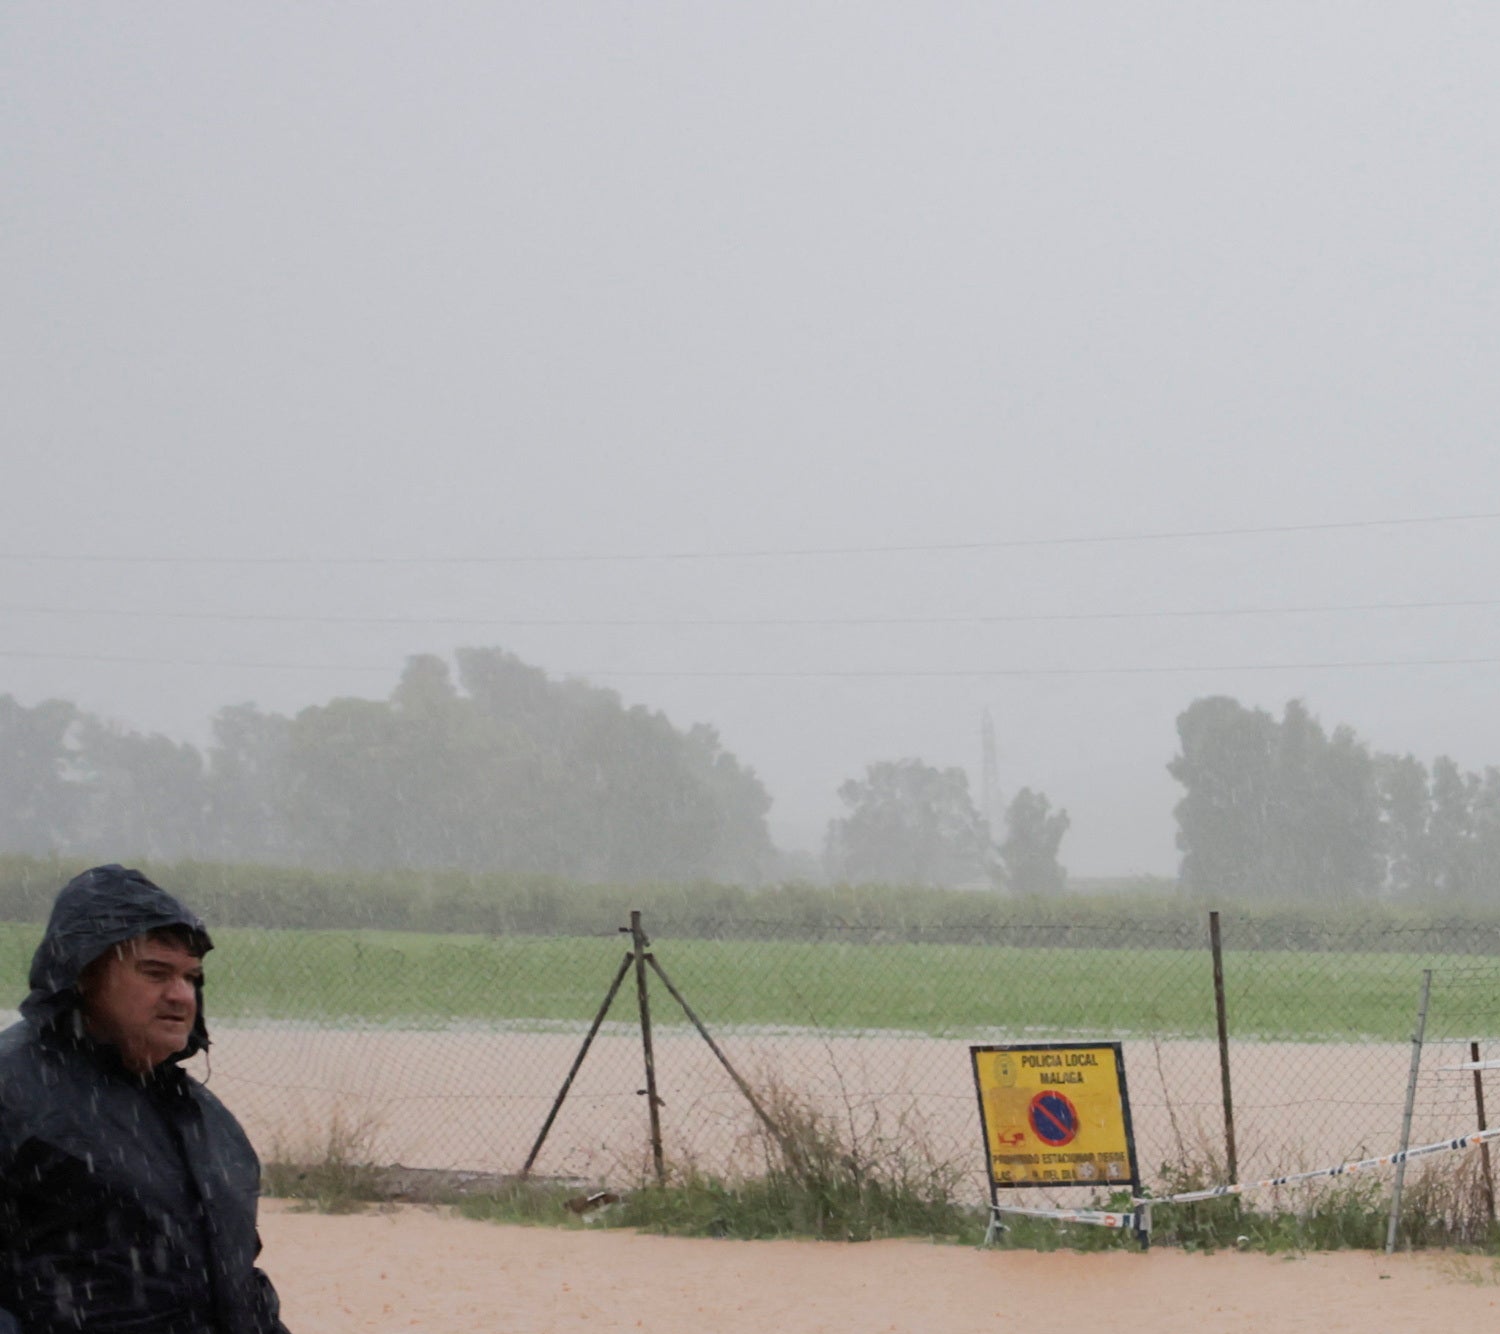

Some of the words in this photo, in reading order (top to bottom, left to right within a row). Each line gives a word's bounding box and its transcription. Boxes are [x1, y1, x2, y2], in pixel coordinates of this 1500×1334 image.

[1021, 1054, 1062, 1068] POLICIA
[1065, 1053, 1098, 1067] LOCAL
[1040, 1071, 1084, 1085] MALAGA
